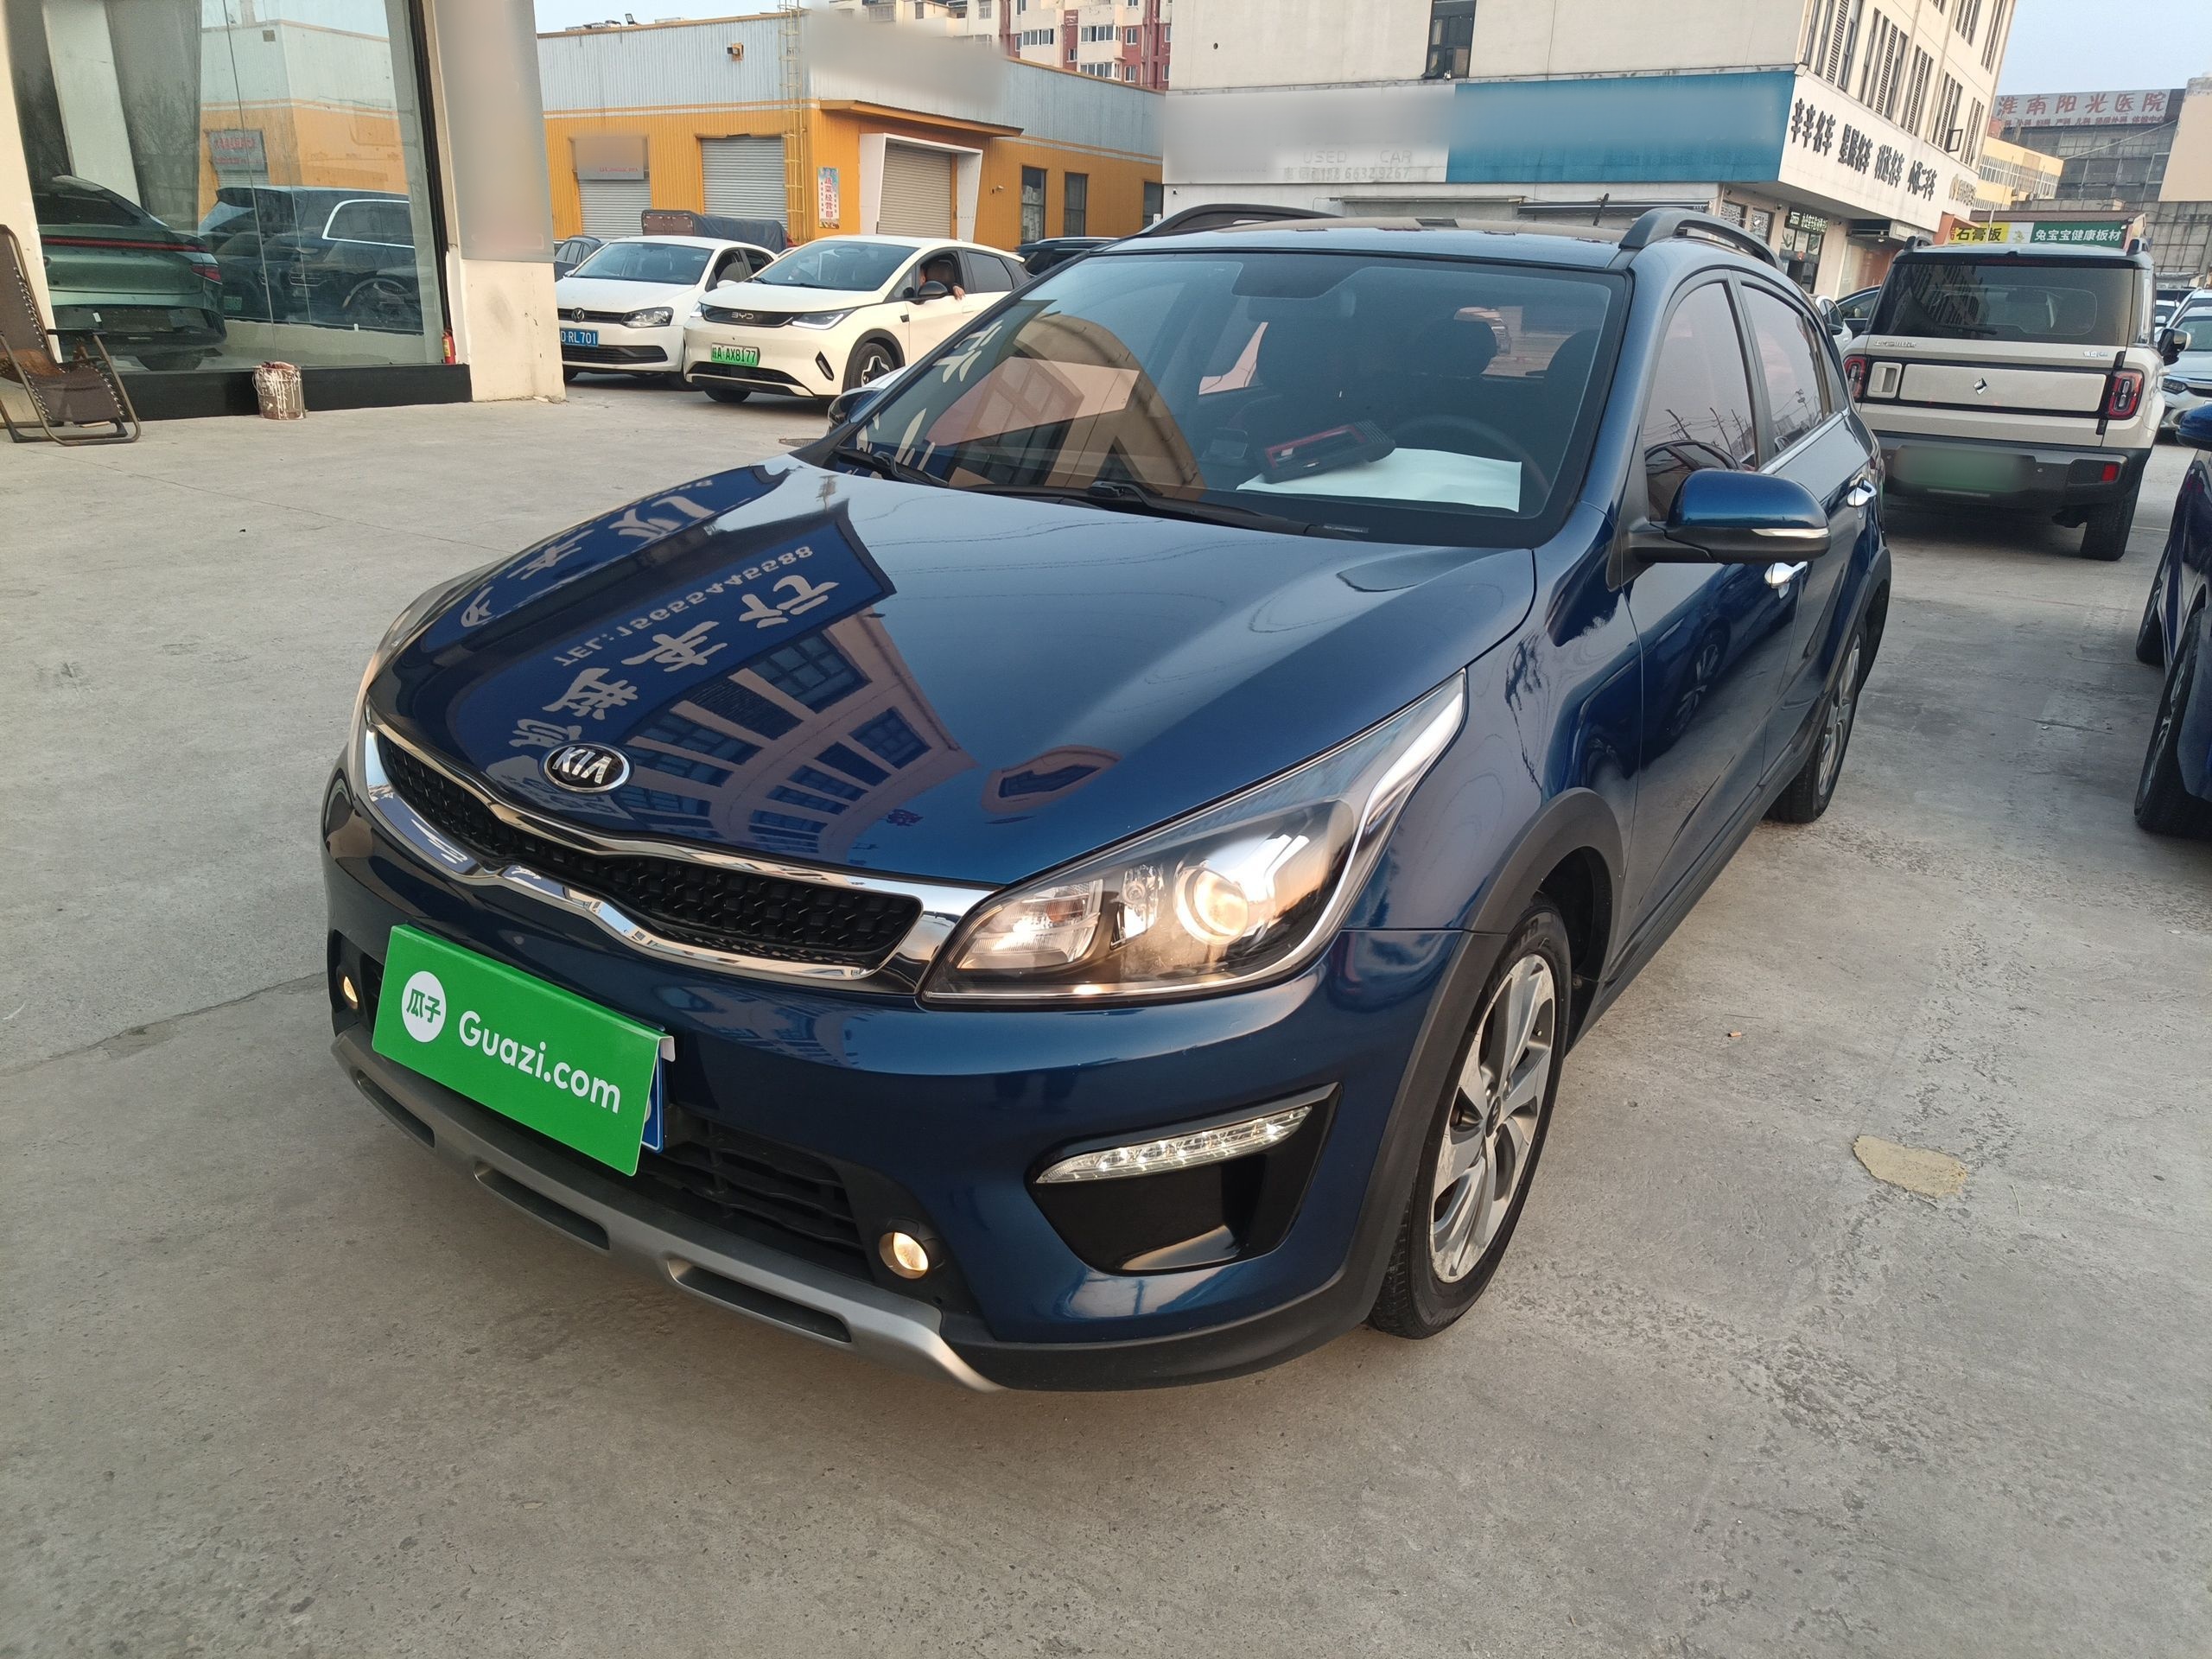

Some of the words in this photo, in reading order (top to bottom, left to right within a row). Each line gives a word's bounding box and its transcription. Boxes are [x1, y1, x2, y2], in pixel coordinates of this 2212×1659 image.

[1997, 92, 2167, 118] 淮南阳光医院
[1303, 150, 1348, 163] USED
[1380, 149, 1413, 163] CAR
[2035, 228, 2122, 242] 兔宝宝健康板材
[551, 746, 613, 785] KIA
[405, 987, 442, 1023] 瓜子
[458, 1009, 622, 1114] Guazi.com
